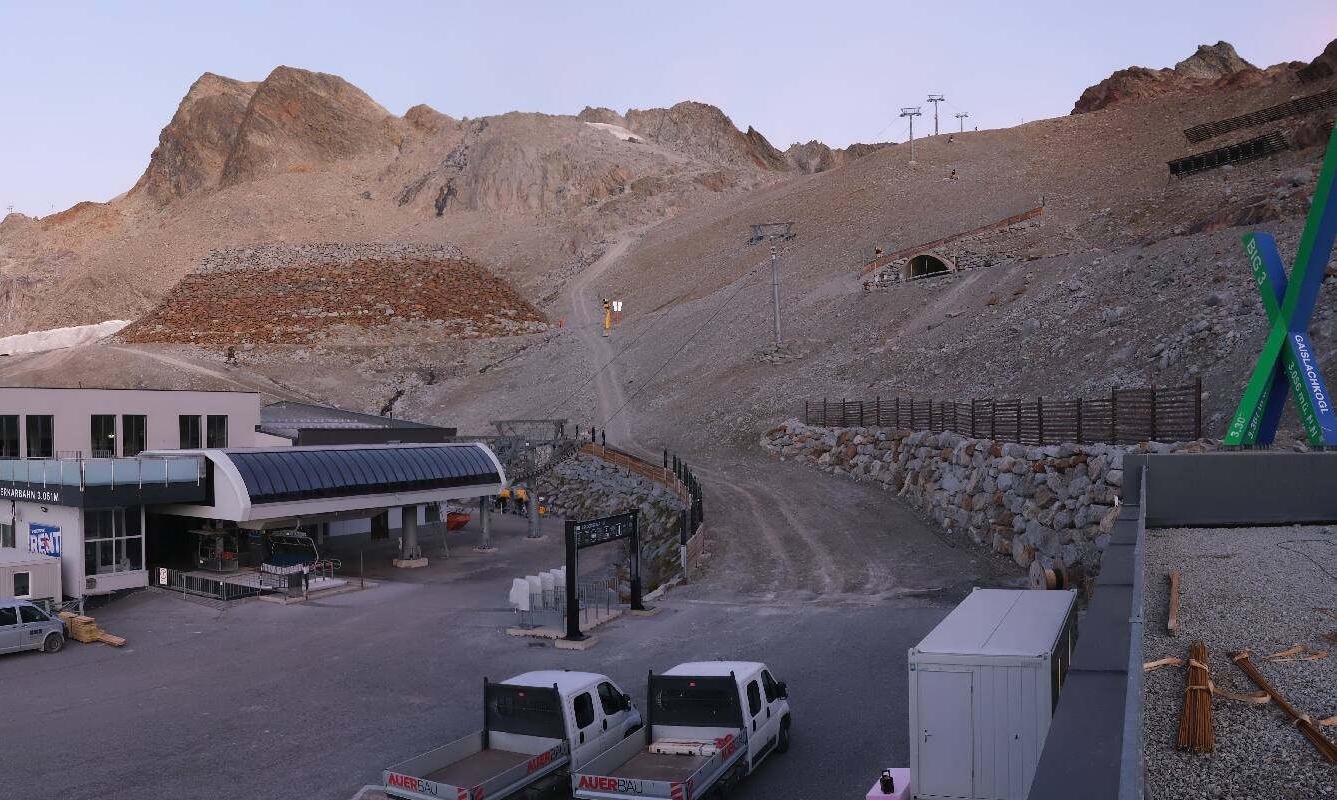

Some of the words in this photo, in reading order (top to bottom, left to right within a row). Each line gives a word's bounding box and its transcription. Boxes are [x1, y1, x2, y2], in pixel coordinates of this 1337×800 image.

[1247, 238, 1262, 271] BIG
[1257, 272, 1267, 286] 3
[1295, 335, 1329, 414] GAISLACHKOGL
